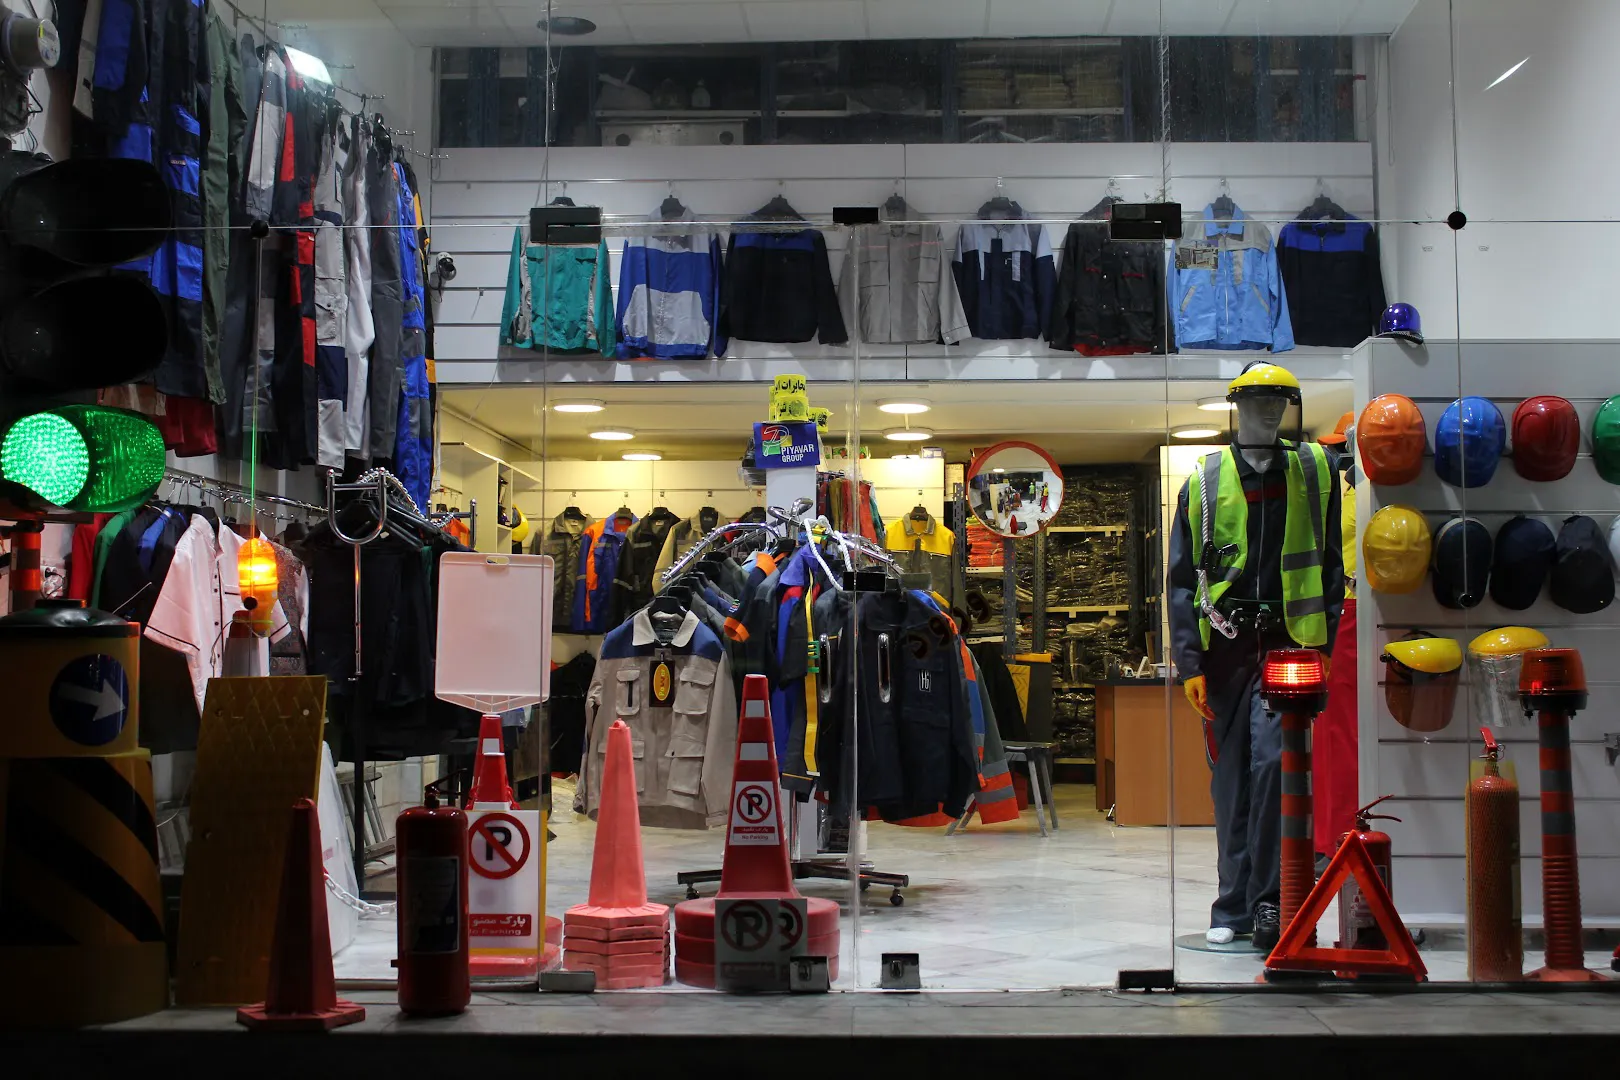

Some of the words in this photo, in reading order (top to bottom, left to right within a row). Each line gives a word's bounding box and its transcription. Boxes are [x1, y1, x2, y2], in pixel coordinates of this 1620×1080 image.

[781, 444, 815, 456] PIYAVAR
[781, 454, 804, 463] GROUP
[499, 915, 526, 928] پارک
